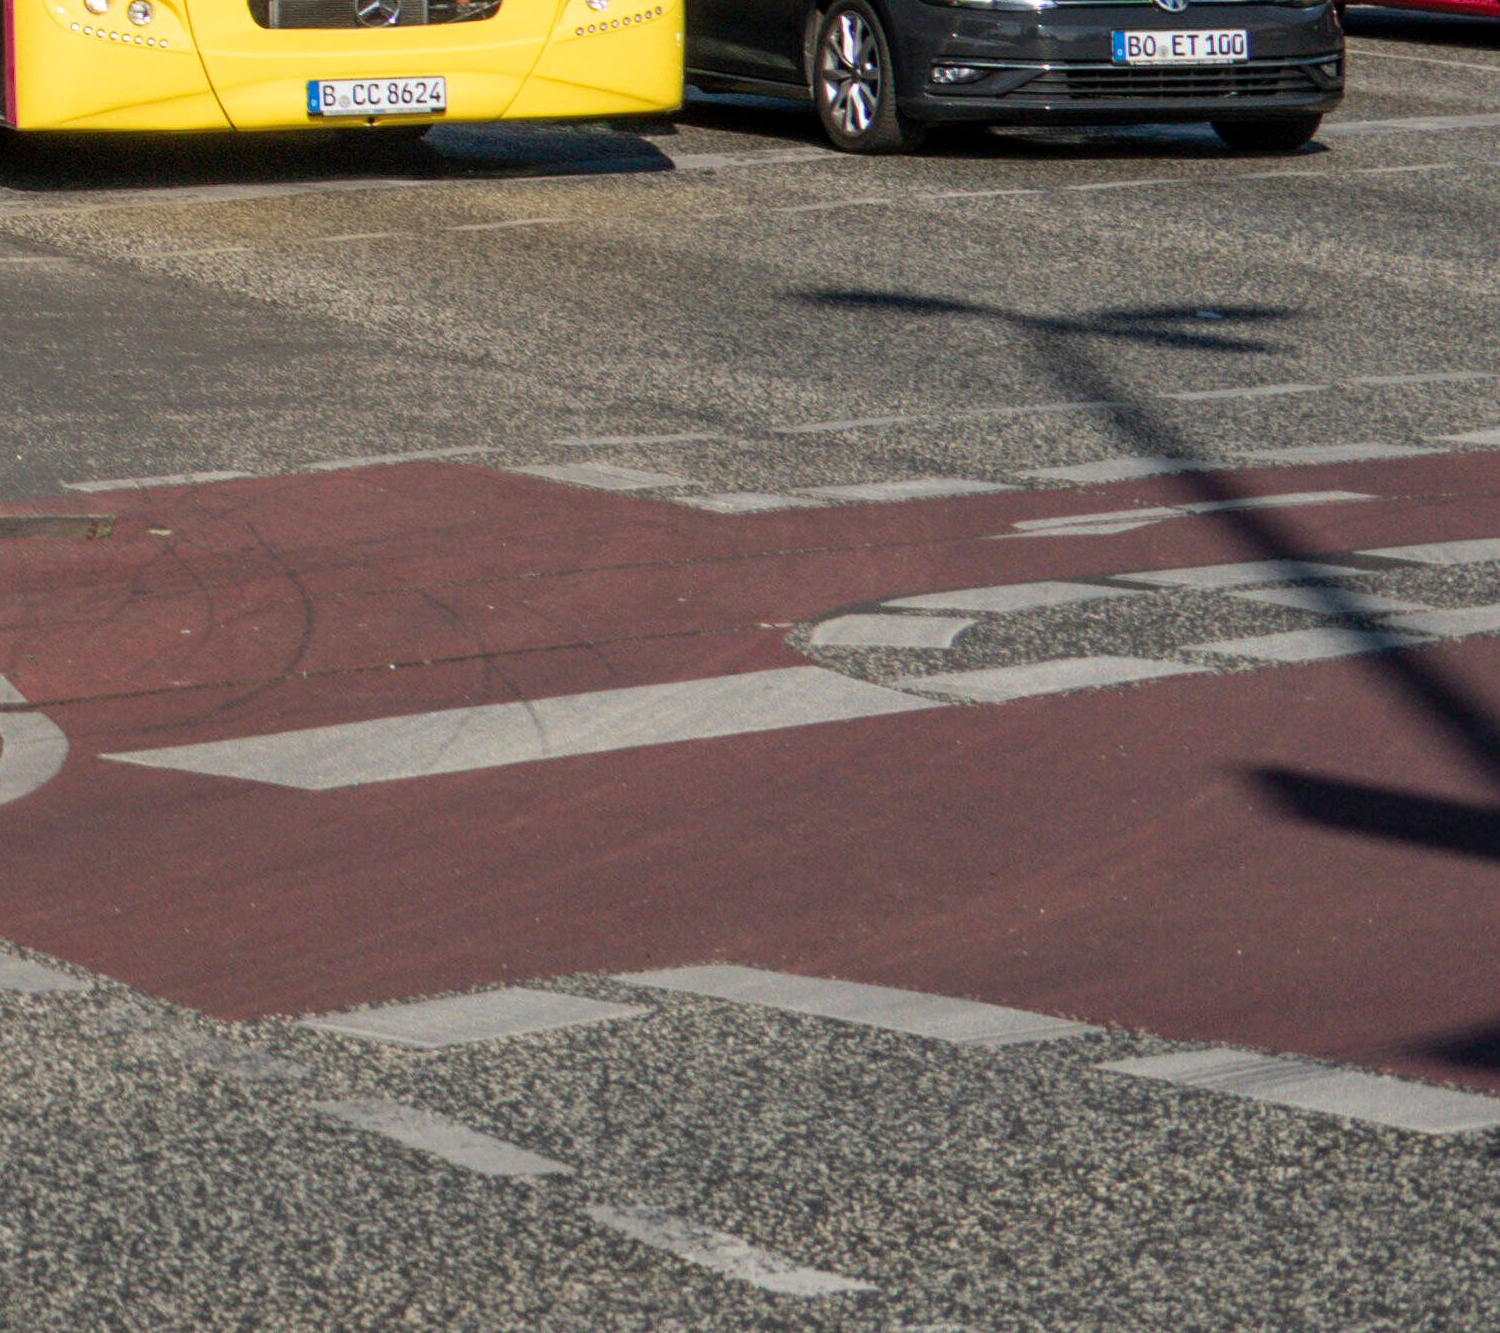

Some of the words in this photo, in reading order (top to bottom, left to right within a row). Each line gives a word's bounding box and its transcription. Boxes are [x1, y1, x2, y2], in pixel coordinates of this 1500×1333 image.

[1128, 35, 1156, 57] BO
[1171, 34, 1200, 56] ET
[1205, 33, 1245, 56] 100
[322, 85, 337, 105] B
[352, 83, 381, 104] CC
[386, 81, 442, 104] 8624
